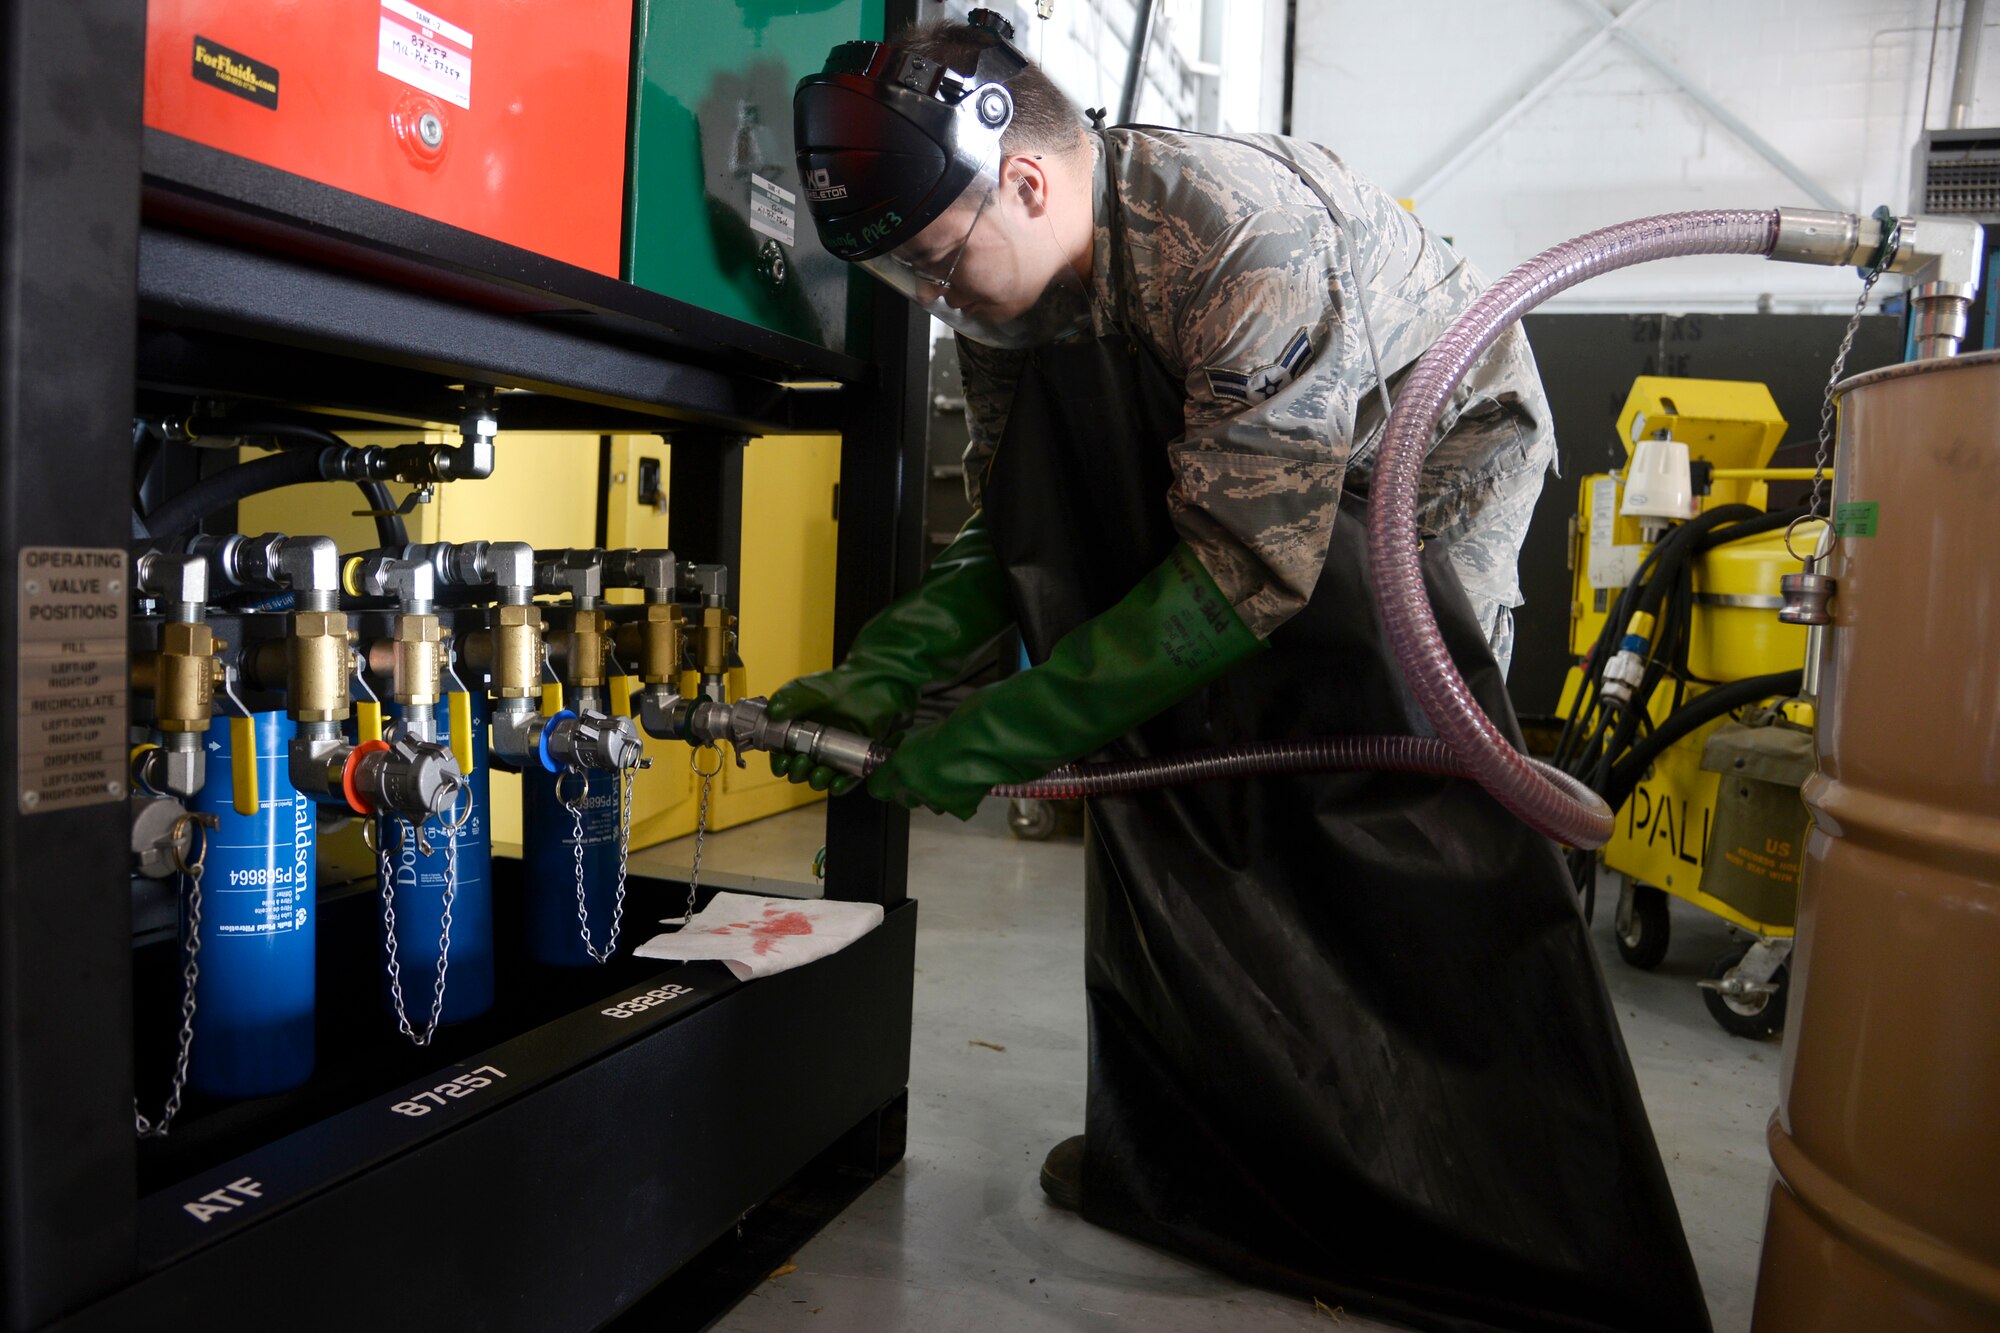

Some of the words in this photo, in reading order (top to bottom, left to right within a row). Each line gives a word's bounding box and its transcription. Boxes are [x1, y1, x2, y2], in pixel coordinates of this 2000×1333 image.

[806, 187, 847, 199] ELETON
[25, 552, 121, 568] OPERATING
[49, 579, 100, 594] VALVE
[29, 604, 118, 620] POSITIONS
[61, 641, 86, 653] FILL
[31, 695, 115, 712] RECIRCULATE
[43, 751, 103, 767] DISPENSE
[295, 790, 312, 896] naldson
[1765, 837, 1791, 857] US
[230, 866, 292, 886] P568664
[219, 924, 255, 932] Filtration
[600, 983, 694, 1019] 83282
[390, 1065, 507, 1117] 87257
[183, 1176, 263, 1223] ATF
